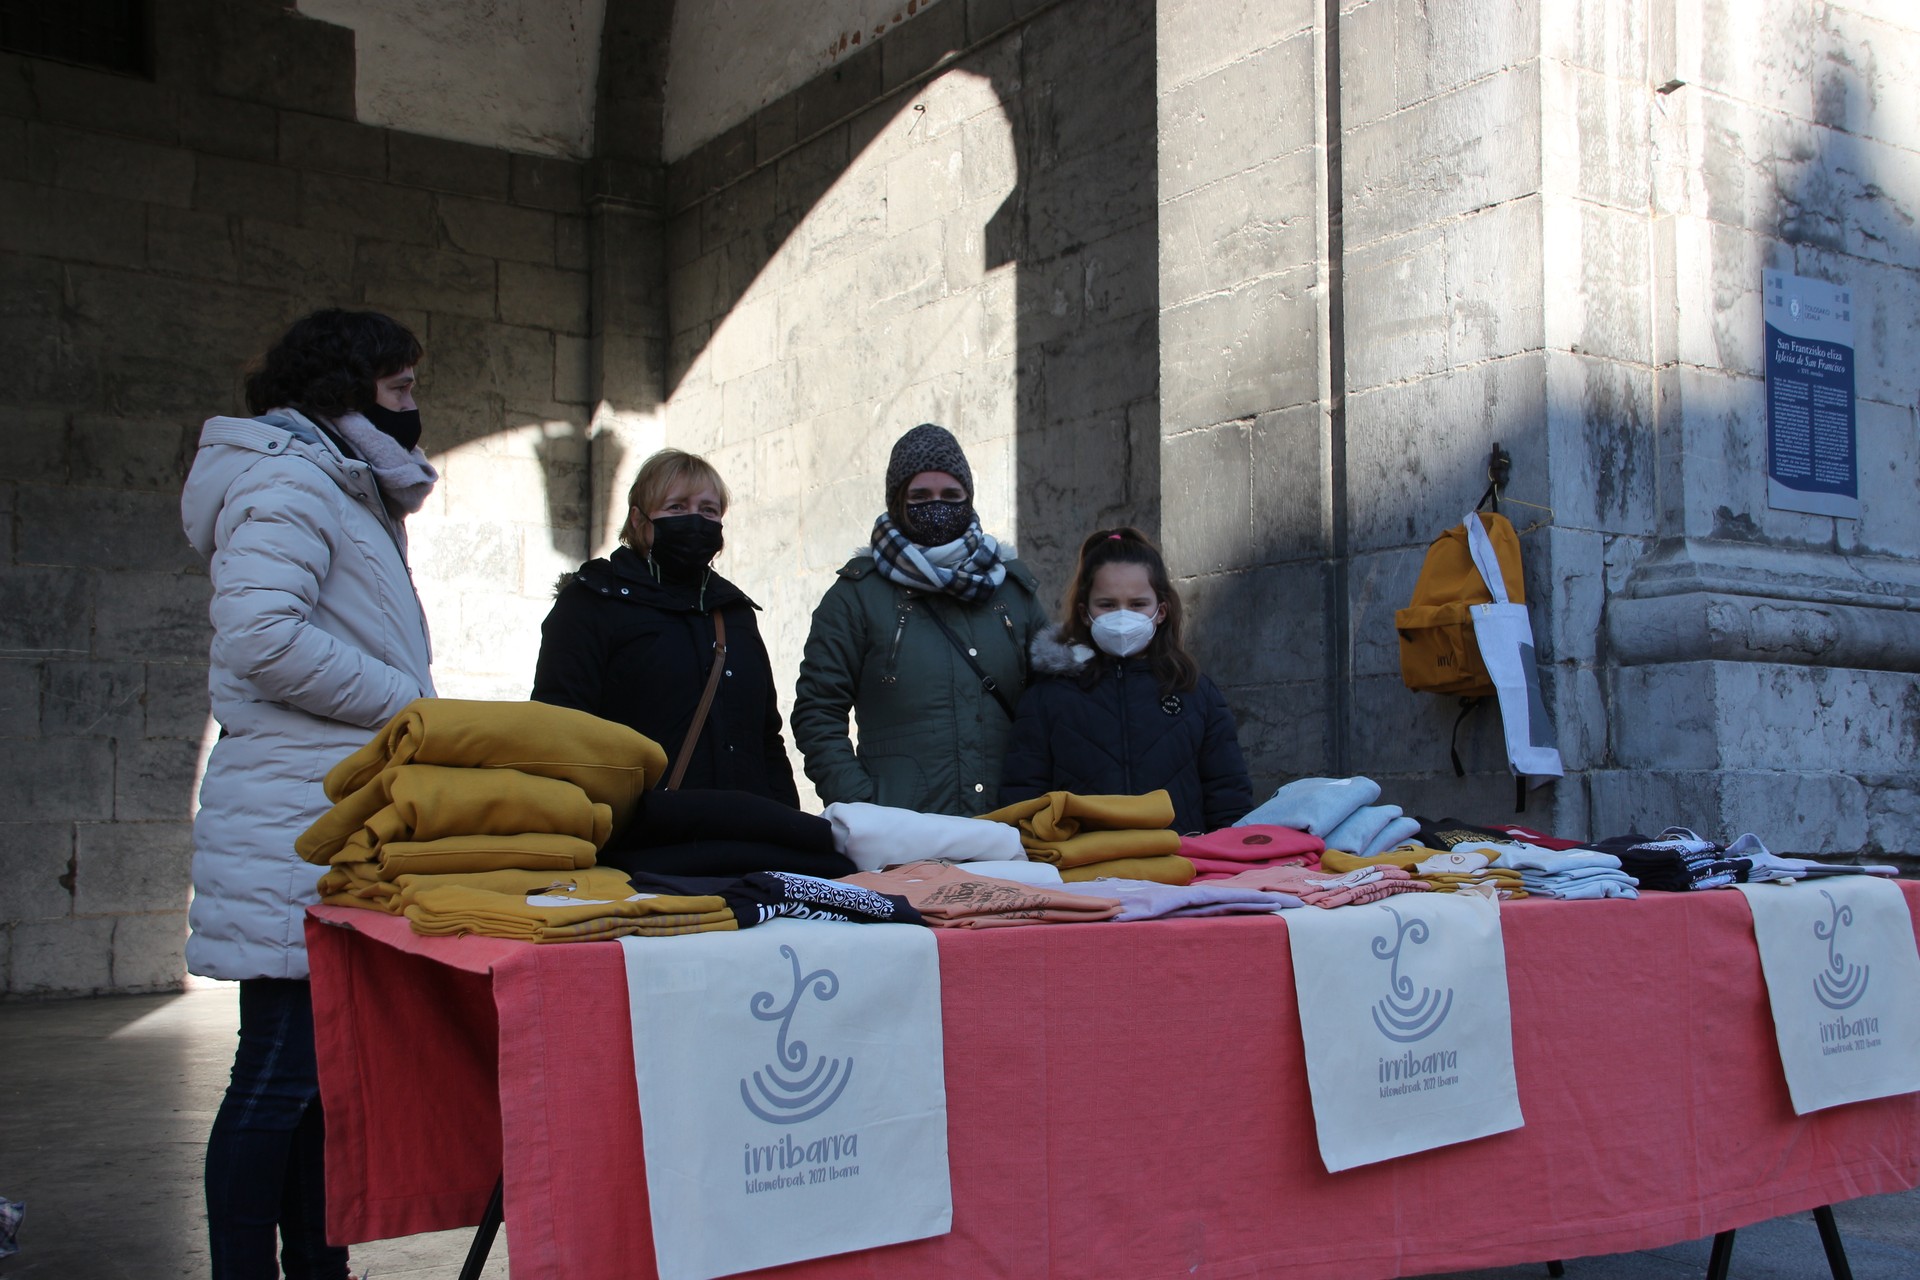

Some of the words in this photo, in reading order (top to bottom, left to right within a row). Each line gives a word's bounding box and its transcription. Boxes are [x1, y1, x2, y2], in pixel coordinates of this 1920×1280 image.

[1775, 350, 1795, 364] Iglesia
[1796, 354, 1804, 365] de
[1805, 355, 1817, 367] San
[1818, 359, 1846, 373] Francisco
[1777, 338, 1790, 350] San
[1791, 341, 1826, 357] Frantzisko
[1827, 348, 1842, 361] eliza
[1819, 1015, 1879, 1043] irribarra
[1379, 1049, 1457, 1083] irribarra
[1379, 1080, 1421, 1099] kilometroak
[1423, 1077, 1436, 1091] 2022
[1437, 1075, 1459, 1088] Ibarra
[744, 1133, 858, 1175] irribarra
[745, 1171, 806, 1195] kilometroak
[808, 1167, 826, 1184] 2022
[829, 1165, 860, 1181] Ibarra
